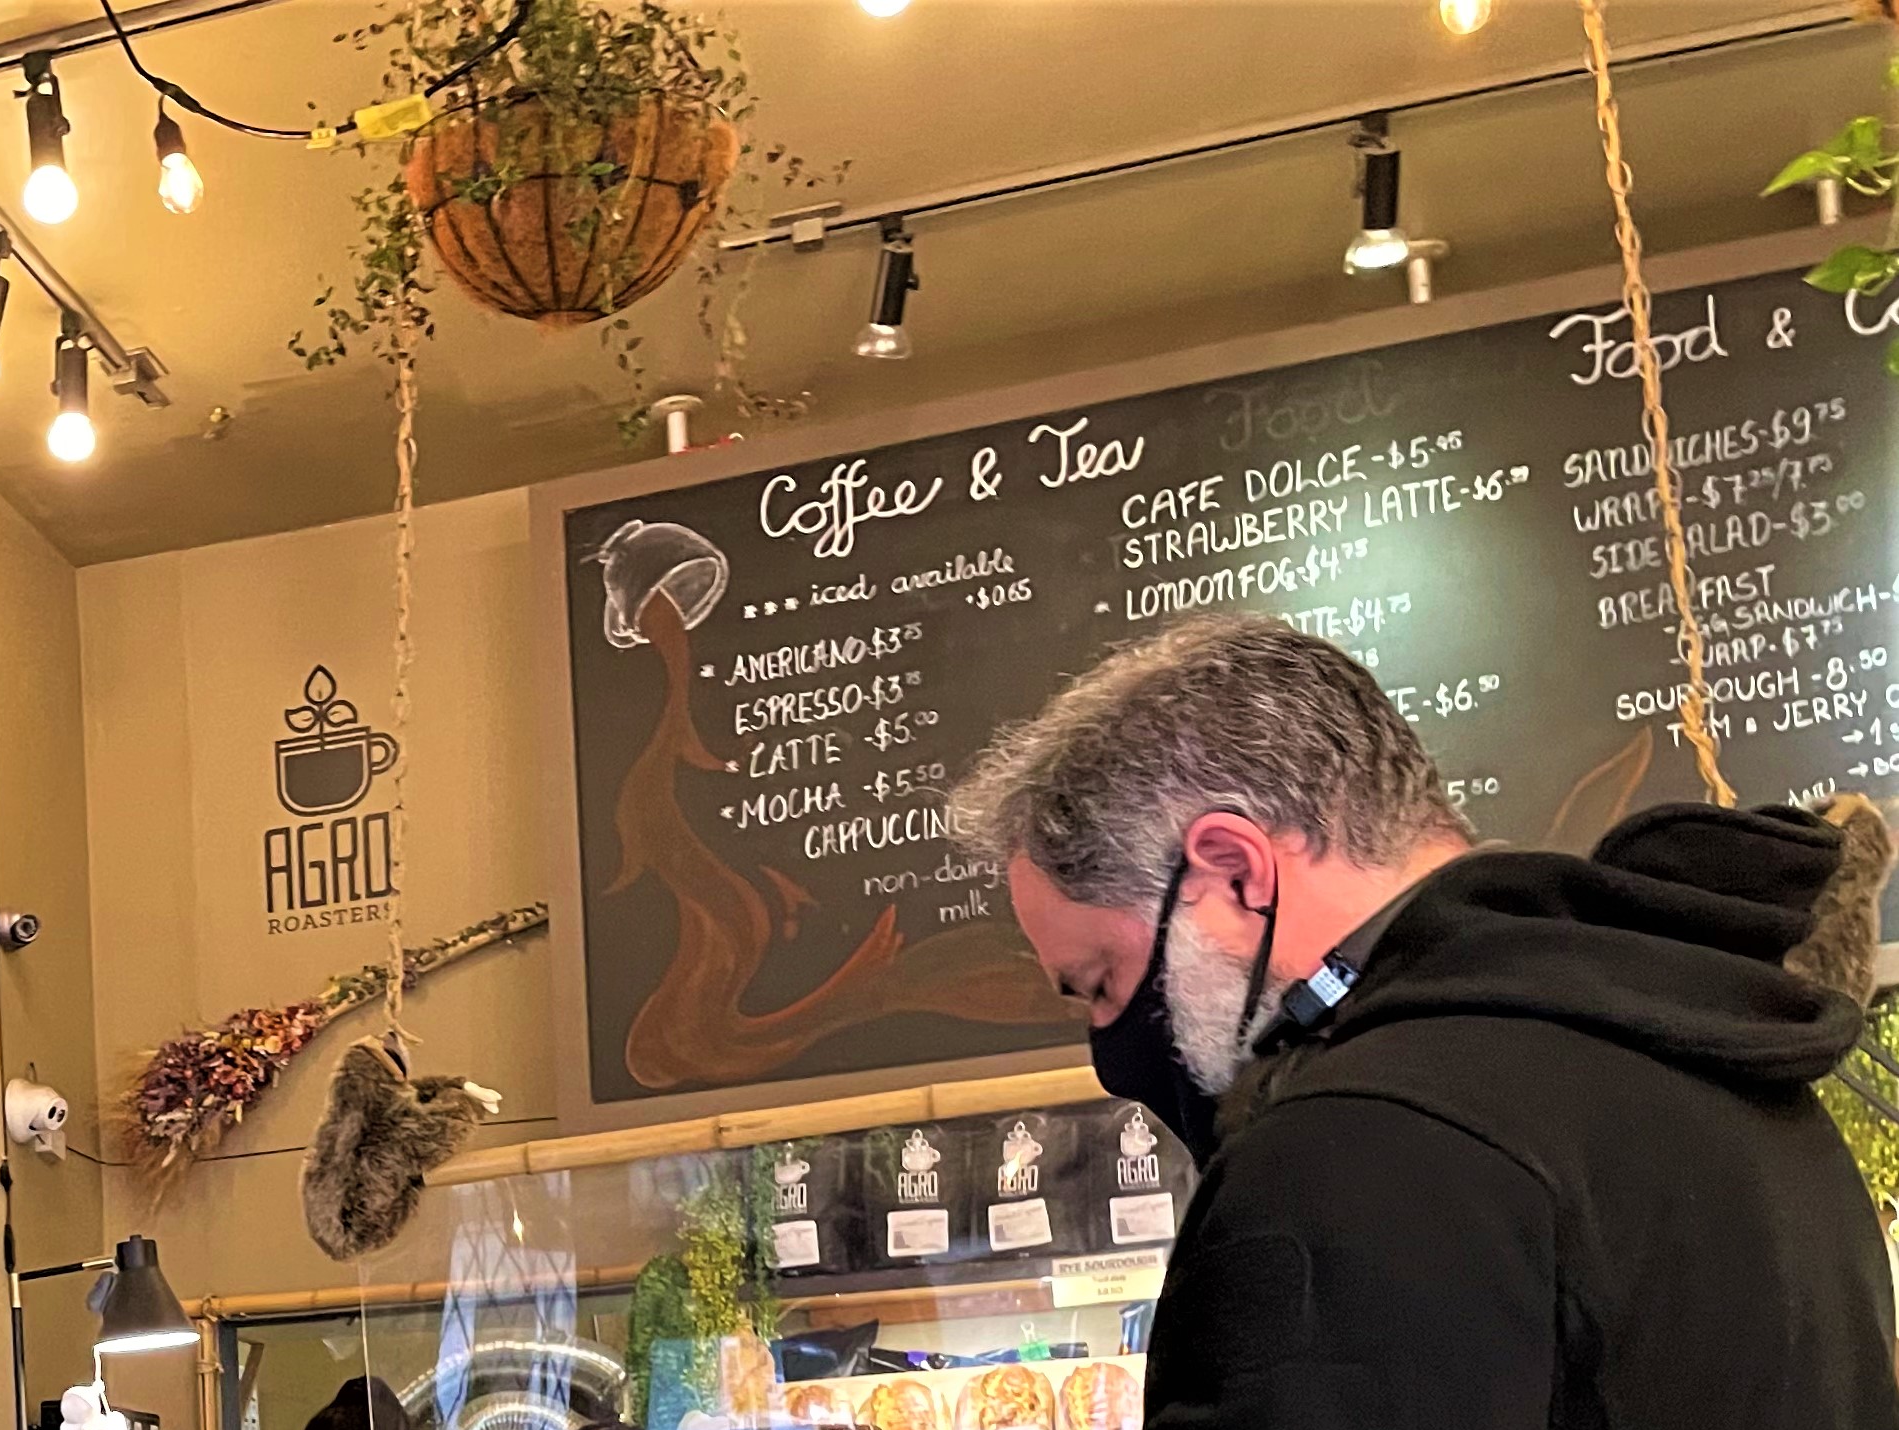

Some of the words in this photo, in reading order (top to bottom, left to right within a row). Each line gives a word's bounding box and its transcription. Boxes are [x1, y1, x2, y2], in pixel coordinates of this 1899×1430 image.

[1547, 294, 1729, 386] Food
[1766, 307, 1797, 349] &
[760, 458, 944, 558] Coffee
[969, 446, 1002, 501] &
[1027, 417, 1145, 489] Tea
[1121, 475, 1225, 530] CAFE
[1245, 444, 1367, 503] DOLCE
[1123, 496, 1348, 570] STRAWBERRY
[1590, 536, 1662, 580] SIDE
[809, 574, 877, 606] iced
[891, 547, 1015, 595] available
[1126, 562, 1235, 622] LONDON
[1598, 564, 1776, 631] BREAFAST
[1666, 714, 1732, 748] TM
[1773, 689, 1868, 732] JERRY
[749, 732, 841, 779] LATTE
[737, 782, 847, 829] MOCHA
[804, 803, 962, 860] CAPPUCCIN
[264, 810, 394, 914] AGRO
[863, 852, 999, 897] non-dairy
[939, 889, 991, 923] milk
[774, 1182, 808, 1211] GRO
[897, 1170, 939, 1199] AGRO
[1117, 1153, 1160, 1186] AGRO
